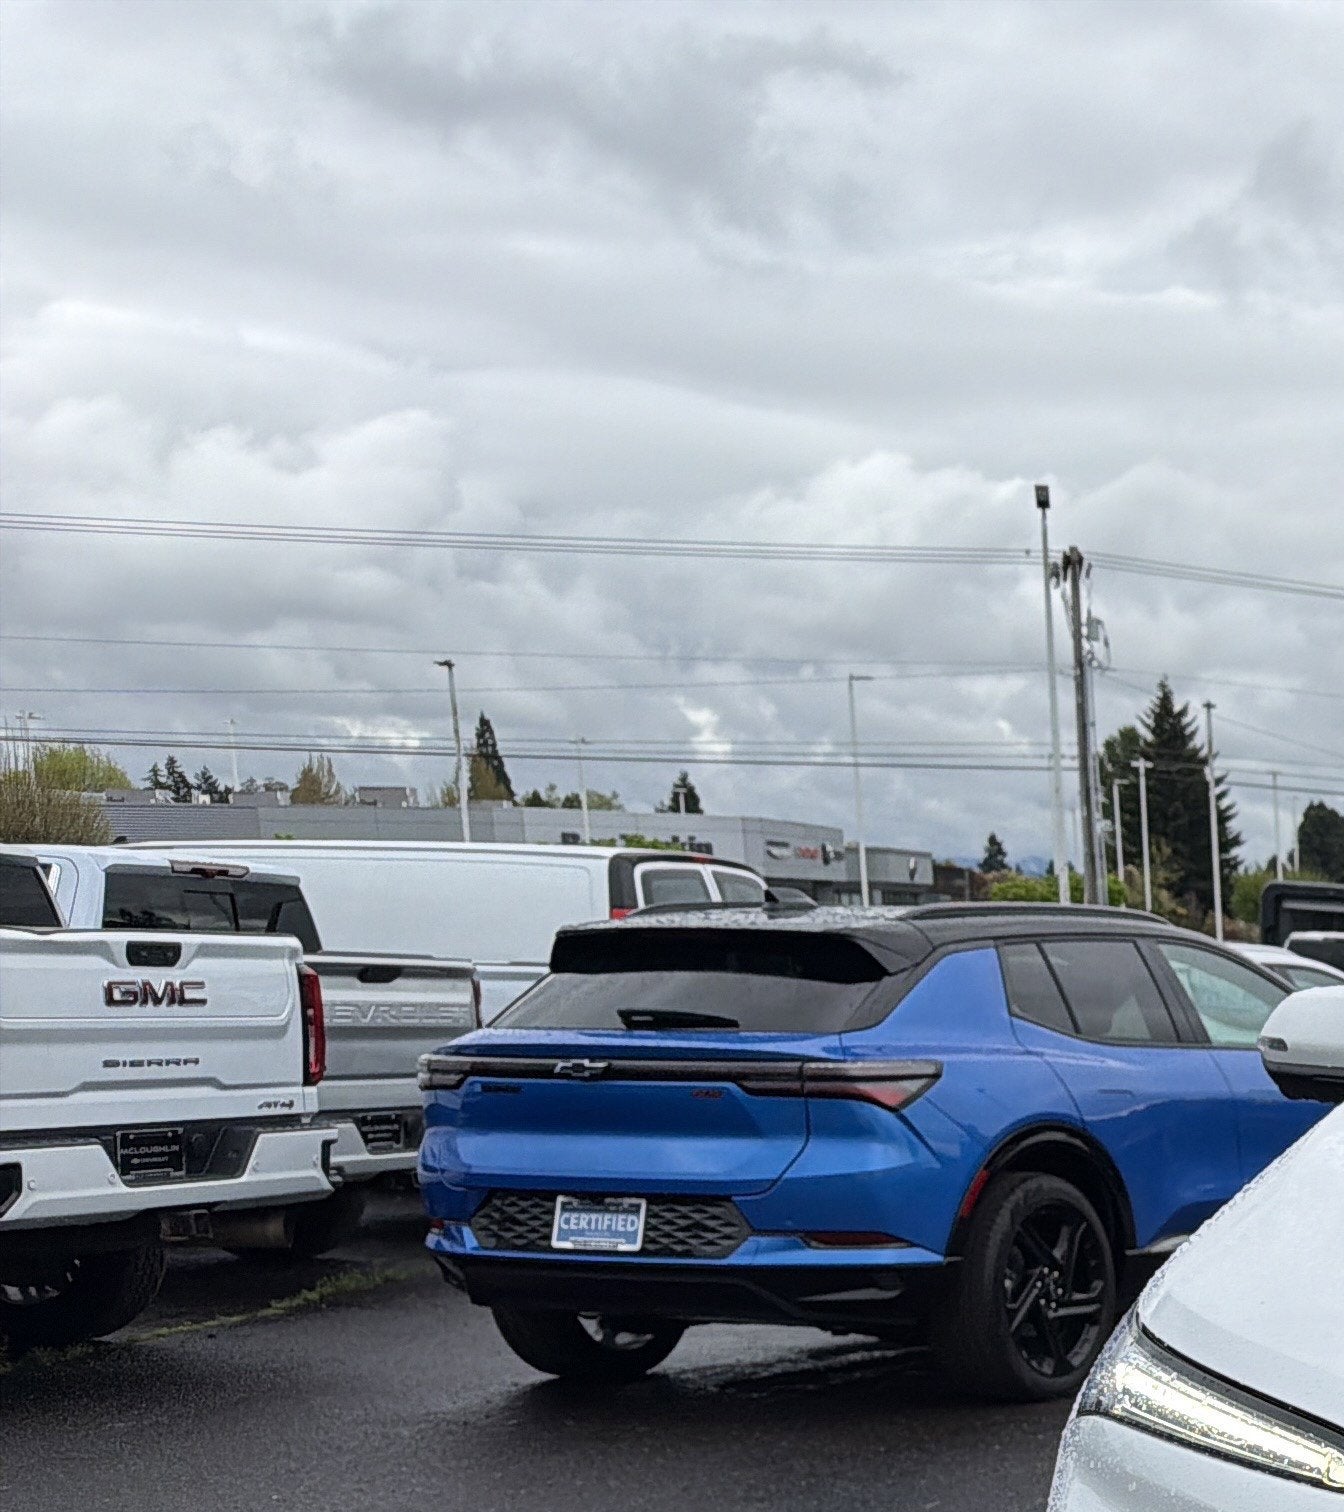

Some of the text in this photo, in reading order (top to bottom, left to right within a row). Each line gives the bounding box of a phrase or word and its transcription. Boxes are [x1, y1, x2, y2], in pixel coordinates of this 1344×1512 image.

[103, 979, 208, 1008] GMC
[102, 1056, 200, 1069] SIERRA
[559, 1211, 640, 1232] CERTIFIED
